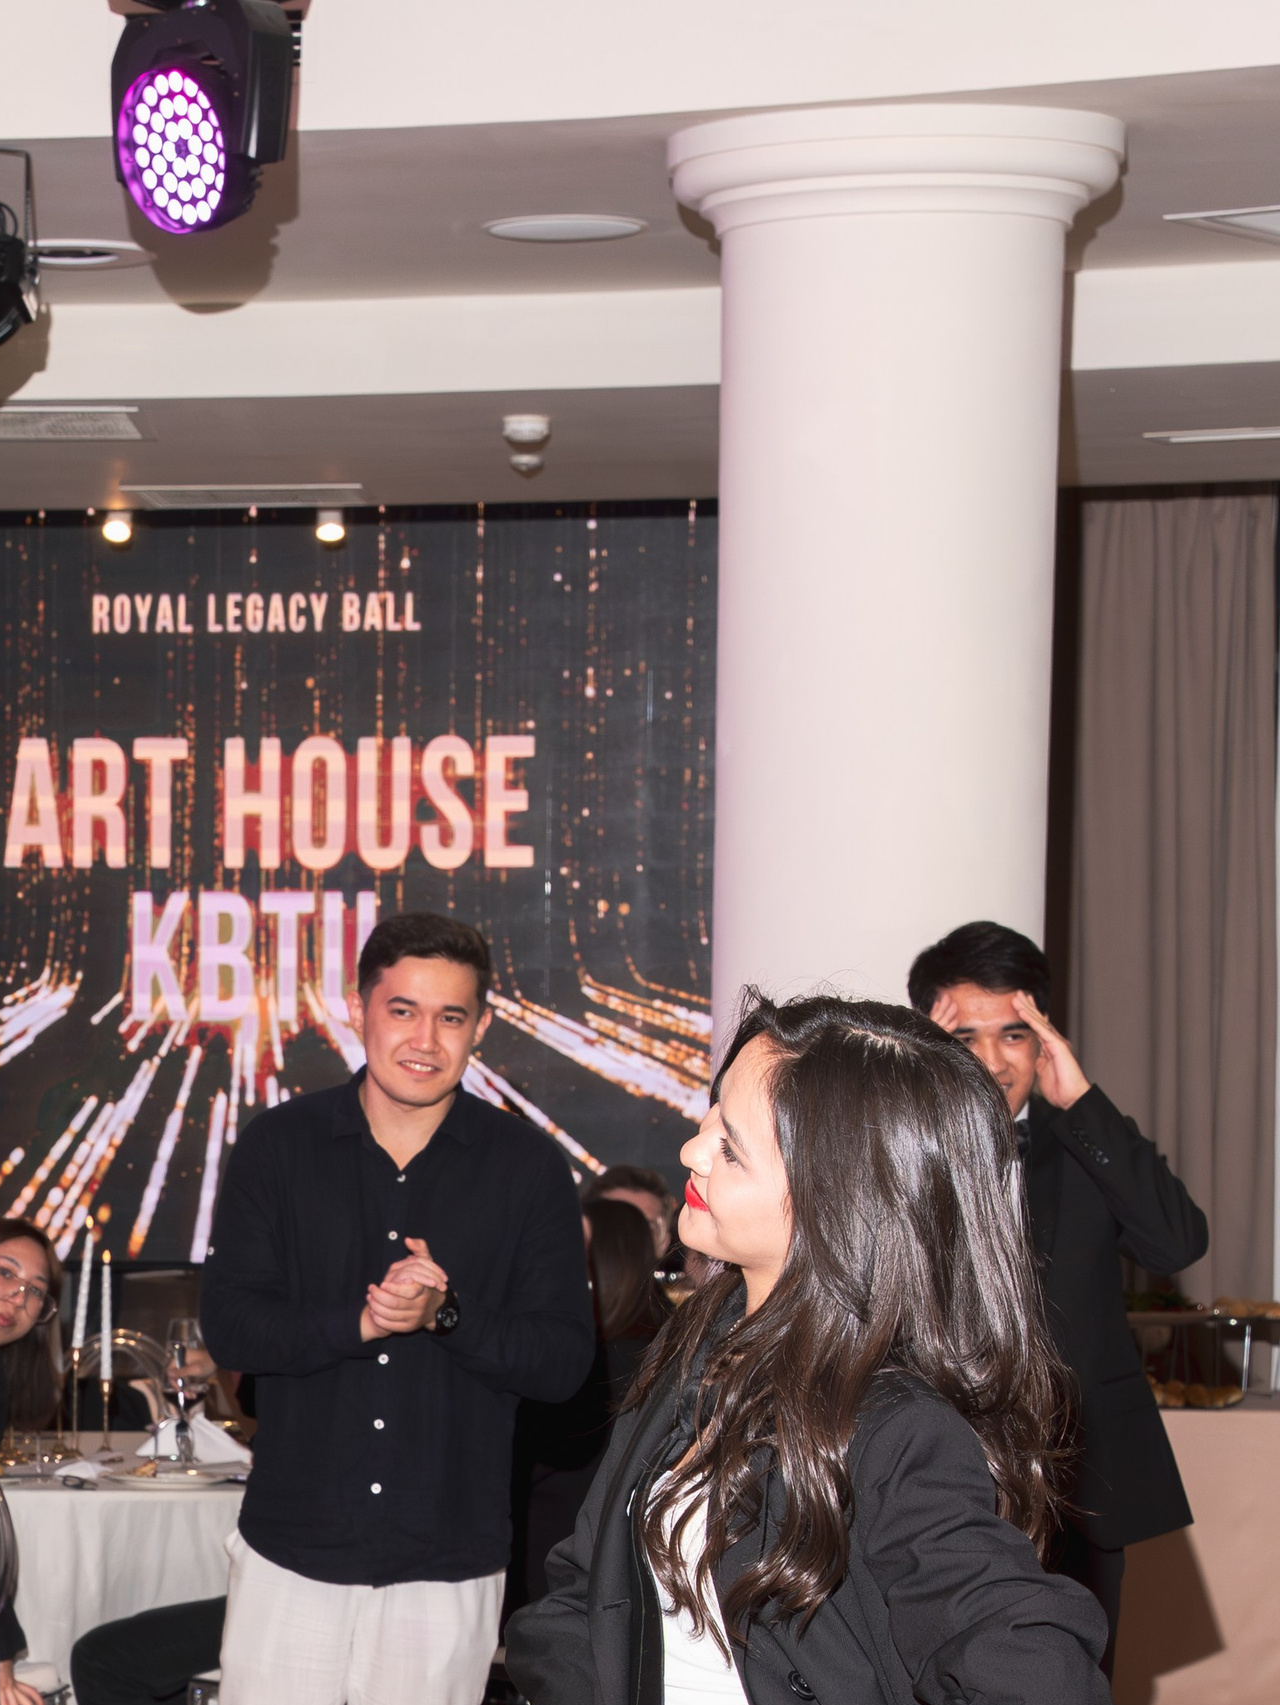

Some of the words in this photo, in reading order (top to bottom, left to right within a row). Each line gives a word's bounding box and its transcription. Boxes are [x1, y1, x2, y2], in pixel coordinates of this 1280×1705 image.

[92, 593, 194, 634] ROYAL
[207, 592, 329, 634] LEGACY
[342, 591, 422, 632] BALL
[4, 737, 189, 868] ART
[223, 735, 535, 870] HOUSE
[132, 890, 377, 1022] KBTU
